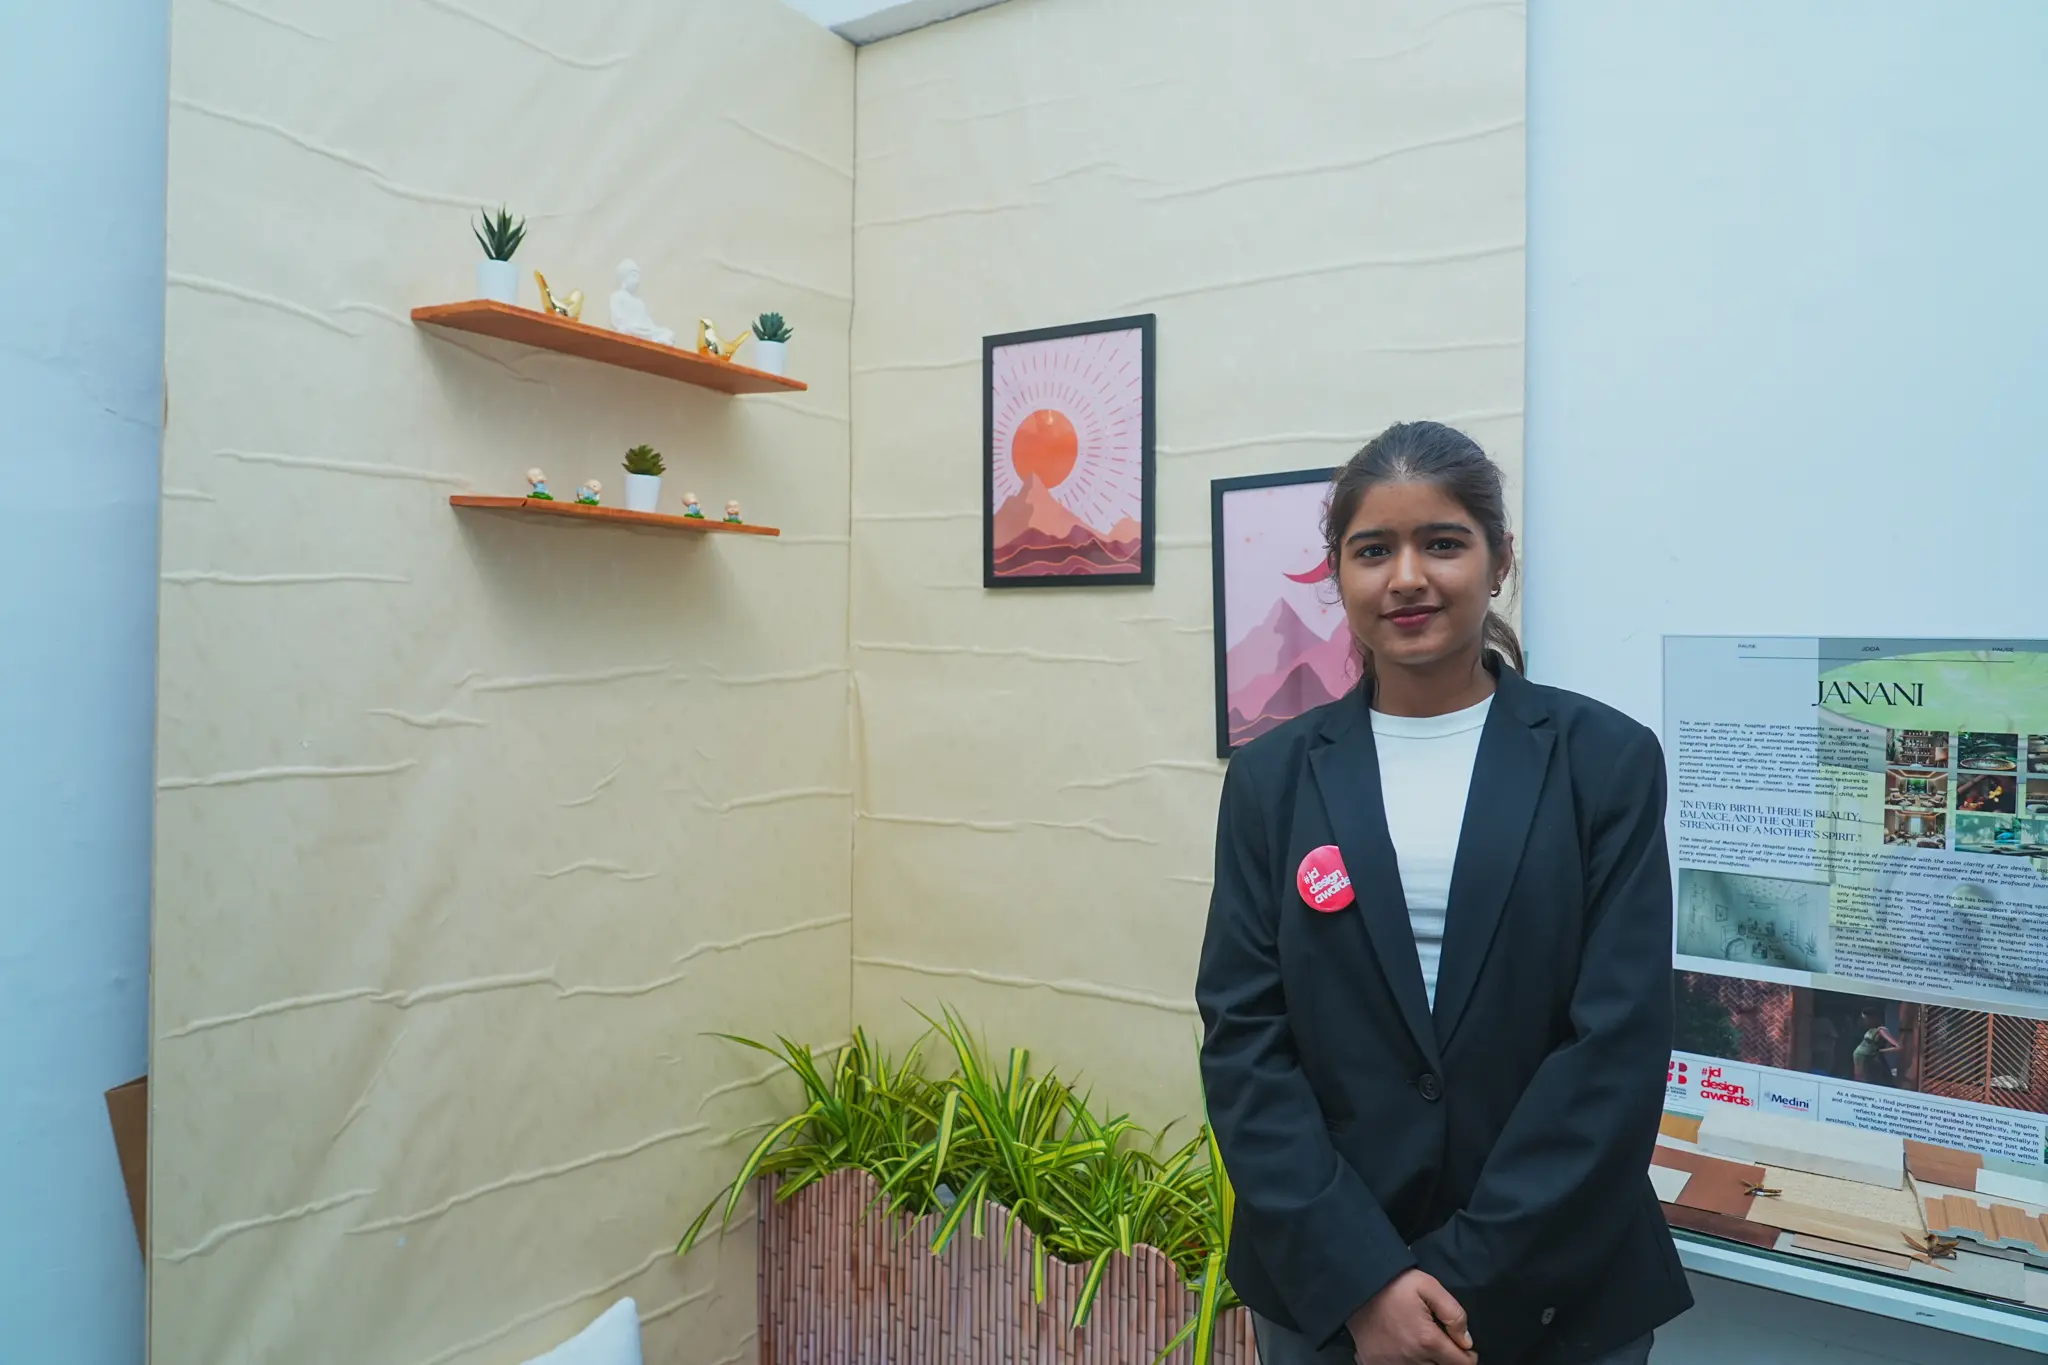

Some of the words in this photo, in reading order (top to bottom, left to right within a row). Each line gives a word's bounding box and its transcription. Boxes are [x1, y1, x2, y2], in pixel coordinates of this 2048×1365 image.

[1811, 680, 1924, 706] JANANI
[1696, 802, 1726, 811] EVERY
[1766, 806, 1801, 816] THERE
[1804, 808, 1812, 817] IS
[1680, 820, 1734, 832] STRENGTH
[1736, 824, 1752, 833] OF
[1754, 826, 1762, 834] A
[1733, 814, 1756, 824] AND
[1758, 816, 1780, 825] THE
[1782, 818, 1816, 828] QUIET
[1304, 867, 1320, 886] #jd
[1309, 869, 1343, 894] design
[1314, 876, 1351, 904] awards
[1701, 1066, 1722, 1081] #jd
[1701, 1079, 1744, 1095] design
[1700, 1090, 1751, 1107] awards
[1771, 1094, 1809, 1108] Medini
[1871, 1104, 1893, 1113] Rooted
[1902, 1110, 1928, 1120] empathy
[1897, 1102, 1921, 1110] purpose
[1930, 1108, 1956, 1118] creating
[1854, 1108, 1876, 1117] reflects
[1883, 1113, 1898, 1122] deep
[1935, 1122, 1956, 1131] human
[1856, 1114, 1887, 1126] healthcare
[1938, 1130, 1961, 1139] believe
[1963, 1134, 1983, 1144] design
[1890, 1129, 1912, 1139] shaping
[2018, 1152, 2038, 1160] within
